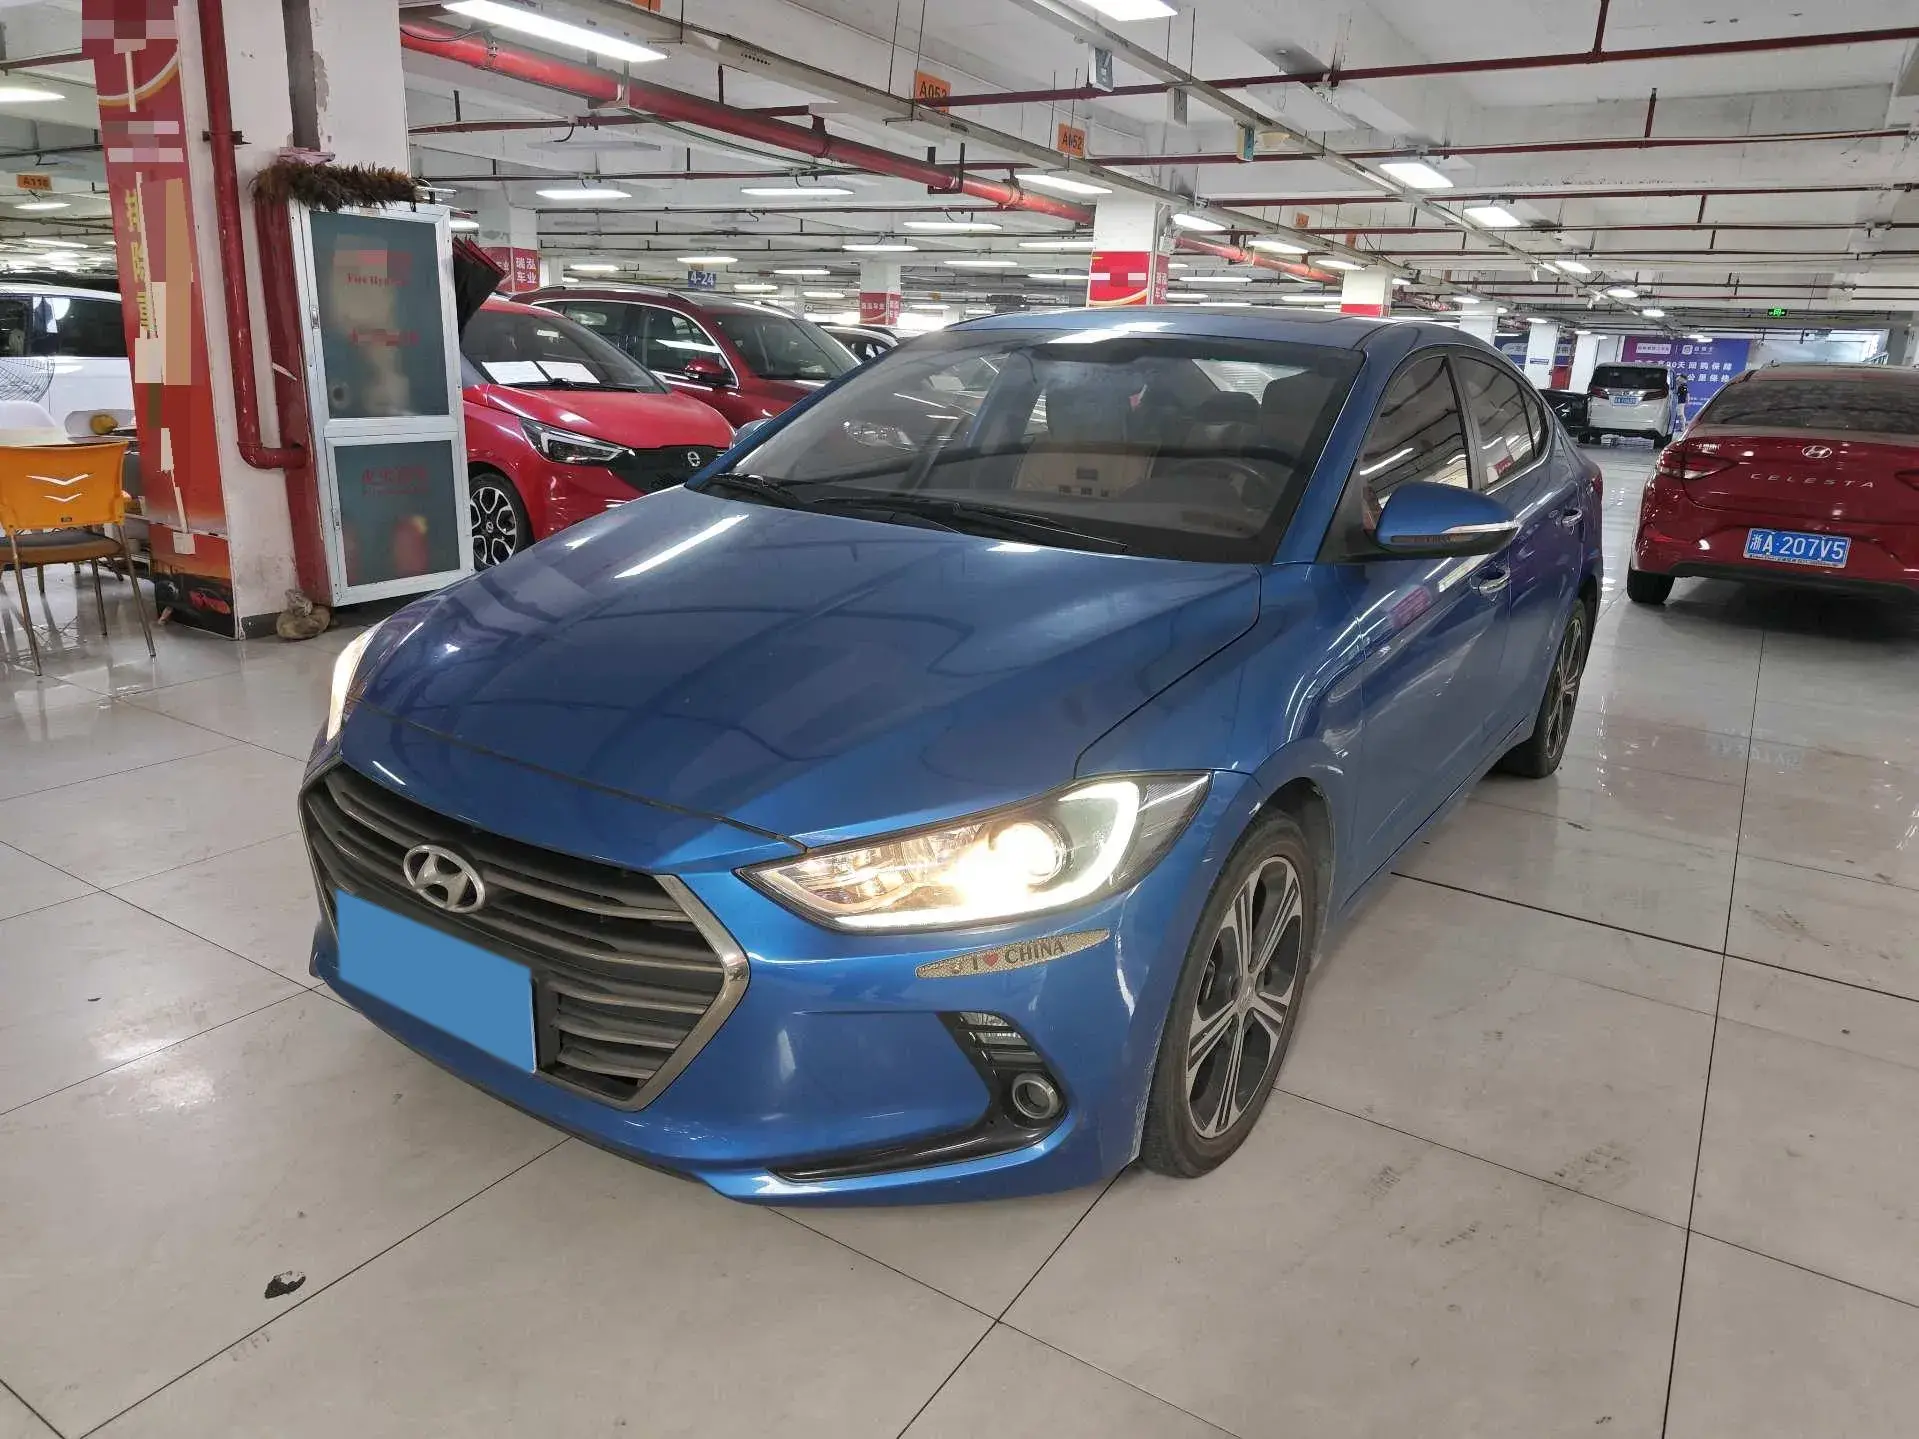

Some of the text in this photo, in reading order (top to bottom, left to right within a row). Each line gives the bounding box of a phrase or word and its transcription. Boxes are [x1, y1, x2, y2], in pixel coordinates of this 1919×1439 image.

[517, 271, 537, 283] 车业
[1750, 473, 1874, 488] CELESTA
[1004, 940, 1066, 964] CHINA
